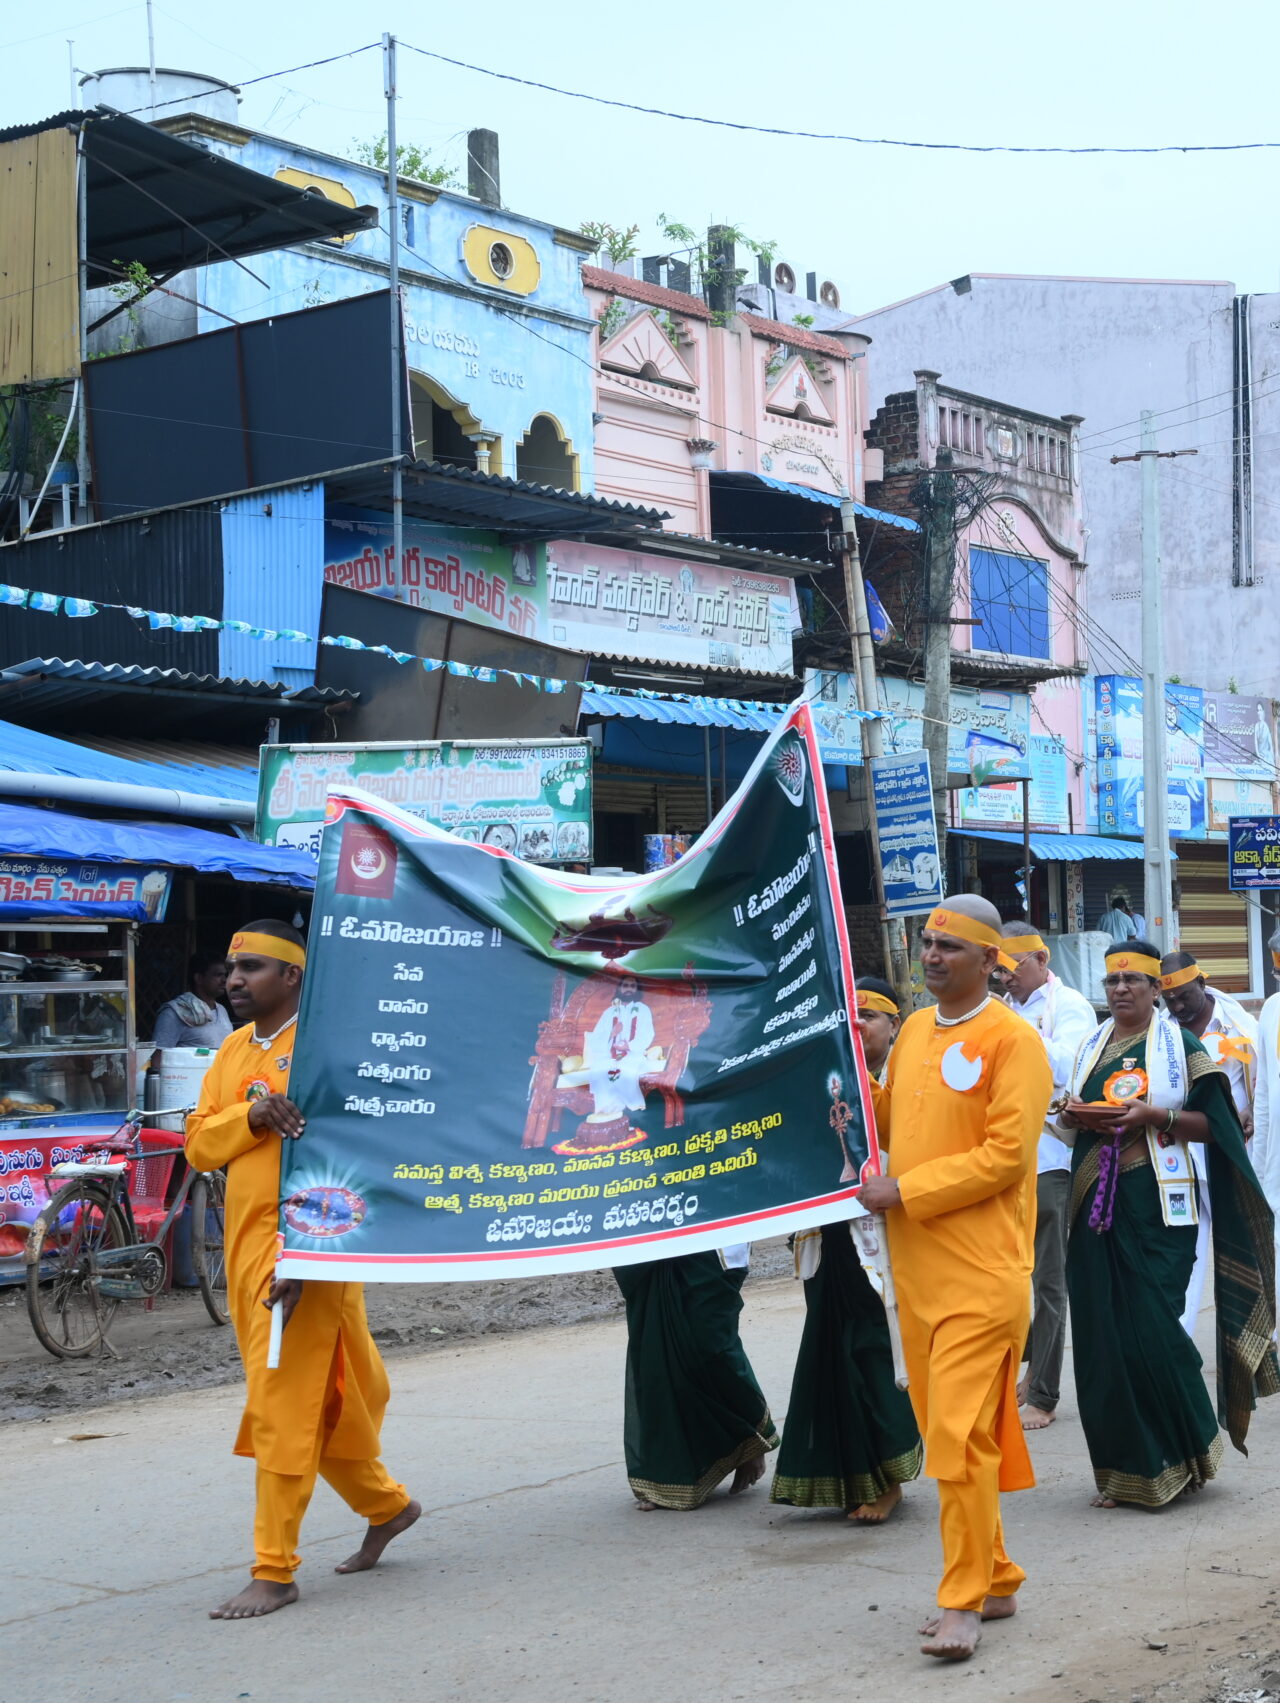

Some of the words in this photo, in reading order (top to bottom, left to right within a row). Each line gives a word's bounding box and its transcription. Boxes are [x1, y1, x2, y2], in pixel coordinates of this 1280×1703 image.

[675, 591, 690, 621] &
[541, 746, 586, 759] 8341518865
[270, 769, 295, 817] శ్రీ
[1234, 850, 1262, 868] ఆక్వా
[393, 962, 424, 982] సేవ
[378, 998, 428, 1015] దానం
[371, 1031, 427, 1052] ధ్యానం
[393, 1164, 445, 1185] సమస్త
[449, 1166, 484, 1184] విశ్వ
[489, 1162, 558, 1183] కళ్యాణం,
[563, 1153, 615, 1174] మానవ
[619, 1142, 681, 1167] కళ్యాణం,
[685, 1128, 728, 1154] ప్రకృతి
[731, 1112, 783, 1139] కళ్యాణం
[424, 1194, 464, 1215] ఆత్మ
[468, 1192, 534, 1213] కళ్యాణం
[538, 1184, 599, 1204] మరియు
[603, 1173, 657, 1199] ప్రపంచ
[661, 1164, 706, 1186] శాంతి
[709, 1147, 758, 1176] ఇదియే
